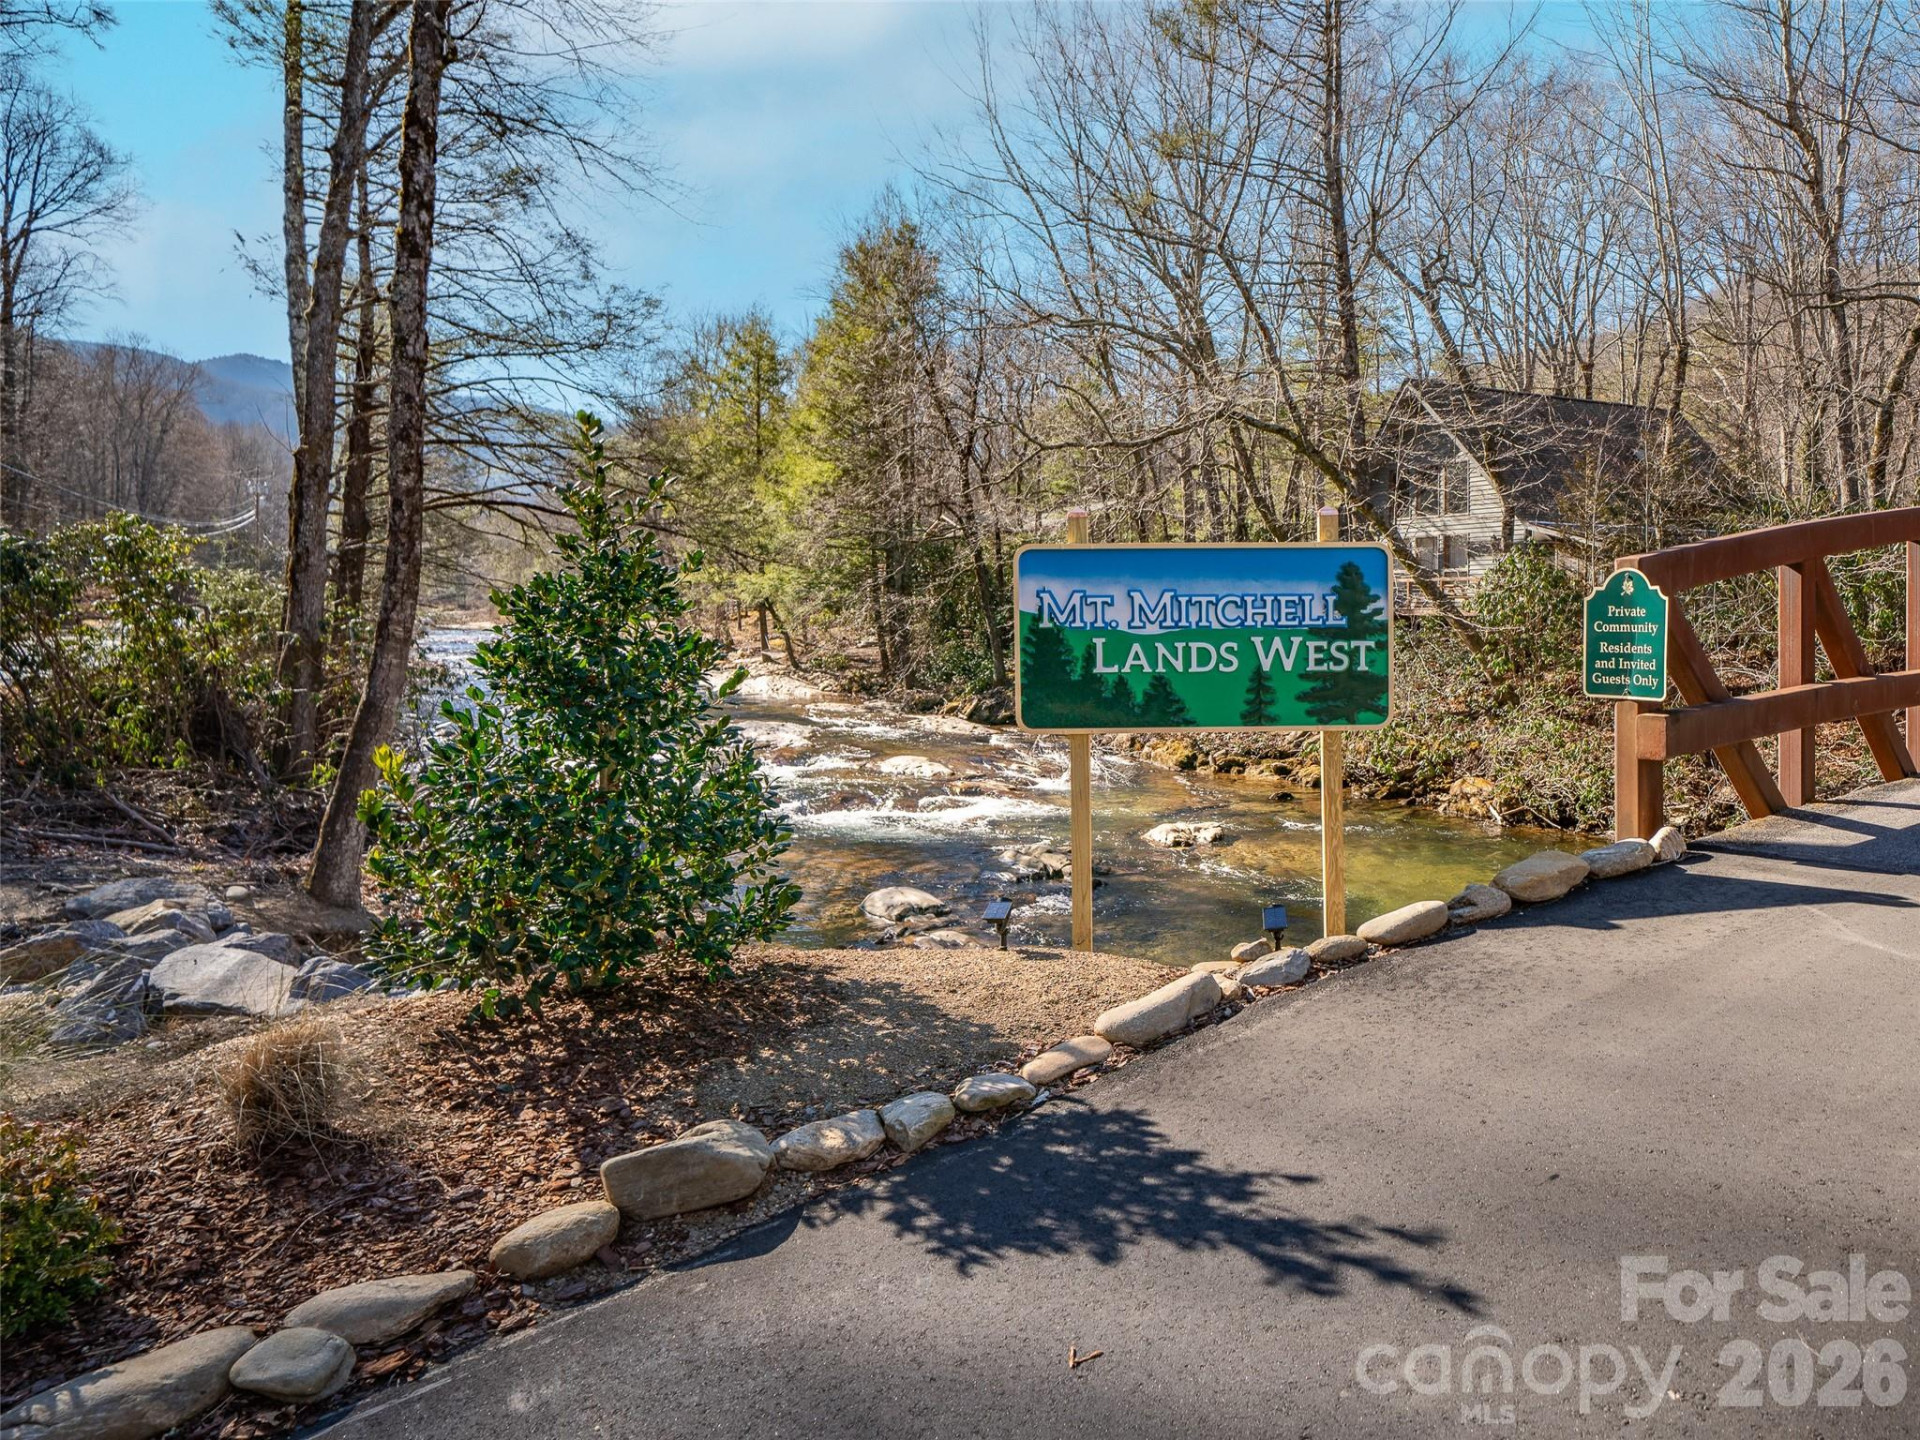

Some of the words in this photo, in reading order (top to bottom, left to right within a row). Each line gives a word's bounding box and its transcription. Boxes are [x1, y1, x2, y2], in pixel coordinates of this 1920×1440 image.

[1128, 589, 1347, 629] MITCHELL
[1608, 605, 1646, 617] Private
[1594, 621, 1658, 636] Community
[1092, 637, 1239, 673] LANDS
[1250, 636, 1376, 672] WEST
[1600, 642, 1652, 654] Residents
[1595, 657, 1615, 669] and
[1619, 658, 1656, 670] Invited
[1592, 673, 1630, 685] Guests
[1633, 674, 1658, 690] Only
